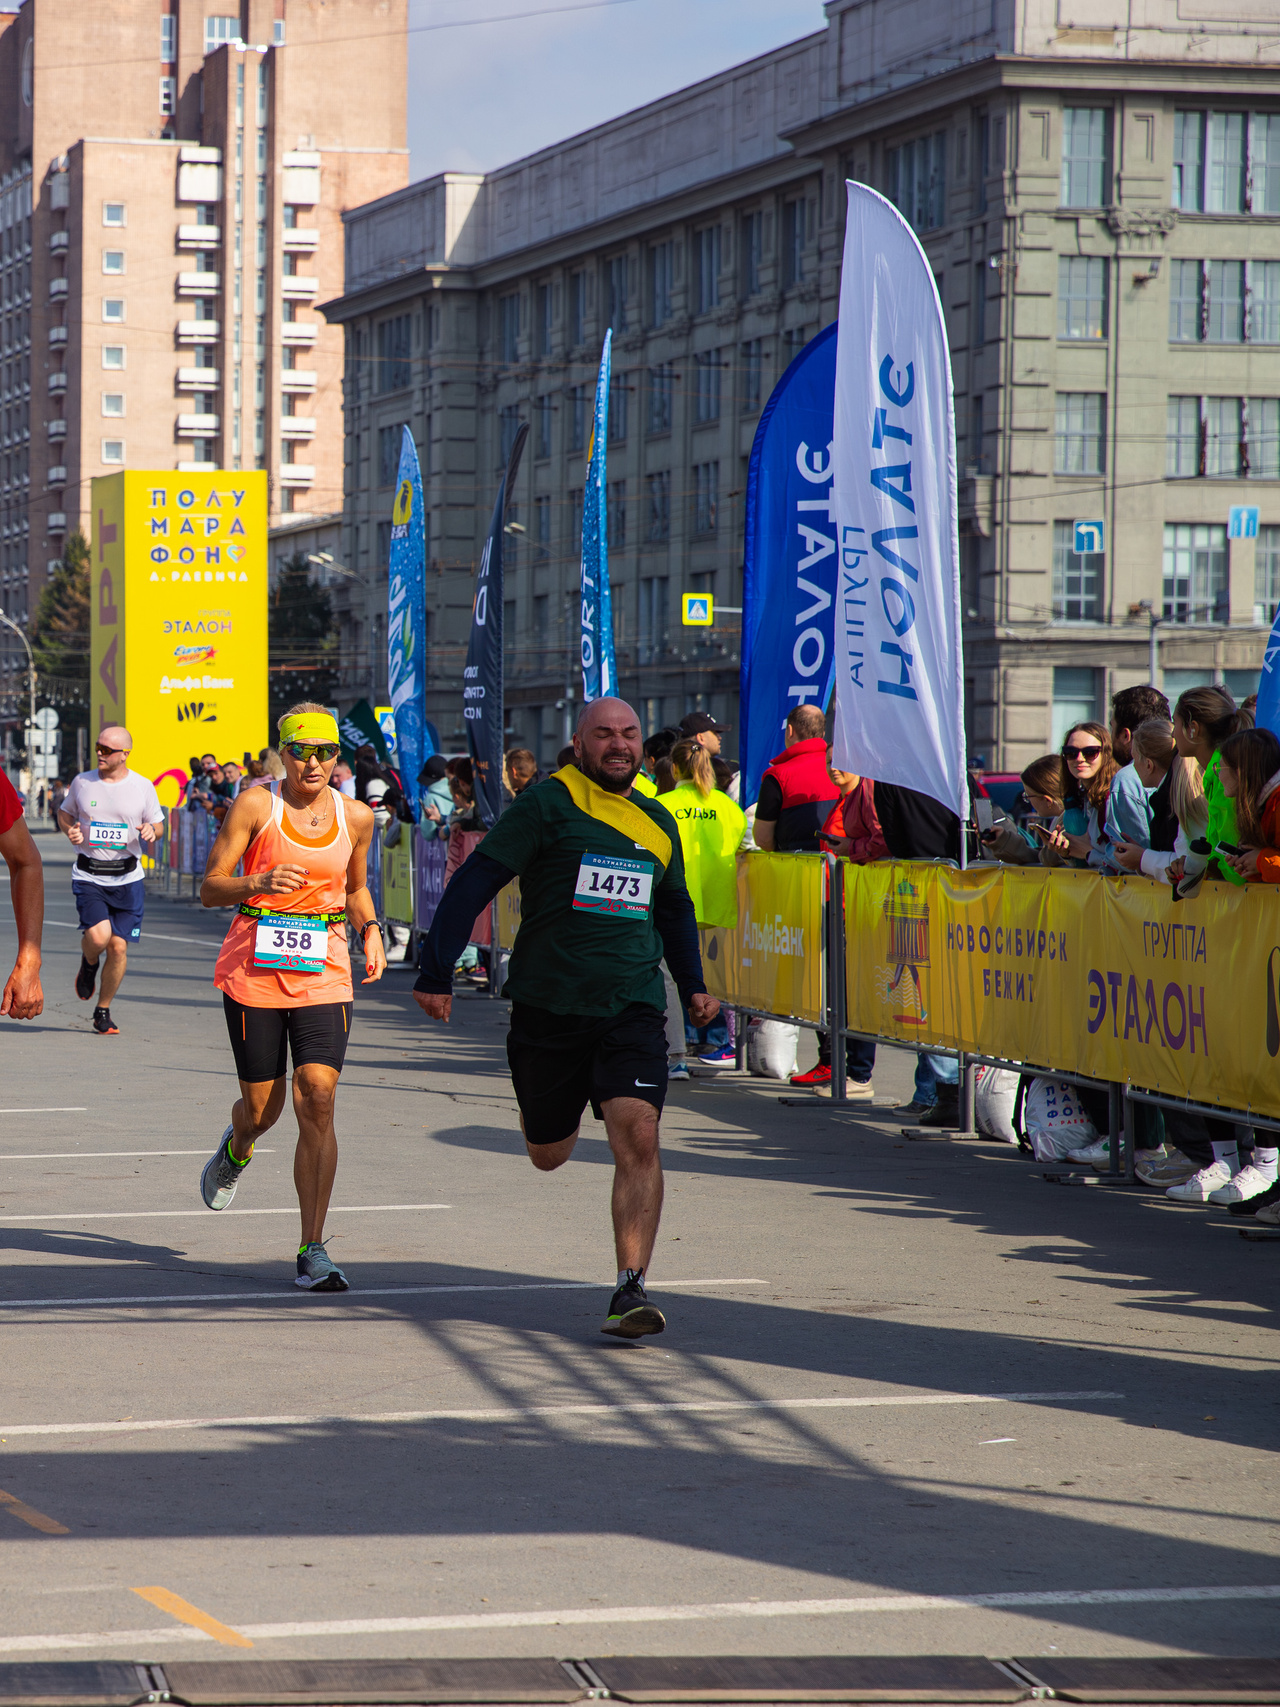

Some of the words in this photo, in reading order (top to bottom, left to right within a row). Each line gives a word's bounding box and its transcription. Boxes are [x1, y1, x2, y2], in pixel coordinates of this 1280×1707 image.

[152, 489, 245, 508] ПОЛУ
[151, 517, 245, 534] МАРА
[150, 546, 220, 564] ФОН
[150, 571, 166, 582] А.
[171, 571, 248, 582] РАЕВИЧА
[163, 620, 232, 633] ЭТАЛОН
[675, 808, 717, 820] СУДЬЯ
[96, 830, 122, 840] 1023
[588, 872, 641, 897] 1473
[599, 898, 624, 913] 26
[272, 930, 312, 950] 358
[947, 922, 1068, 961] НОВОСИБИРСК
[1142, 921, 1207, 964] ГРУППА
[278, 954, 301, 967] 26
[982, 968, 1034, 1003] БЕЖИТ
[1087, 969, 1209, 1057] ЭТАЛОН
